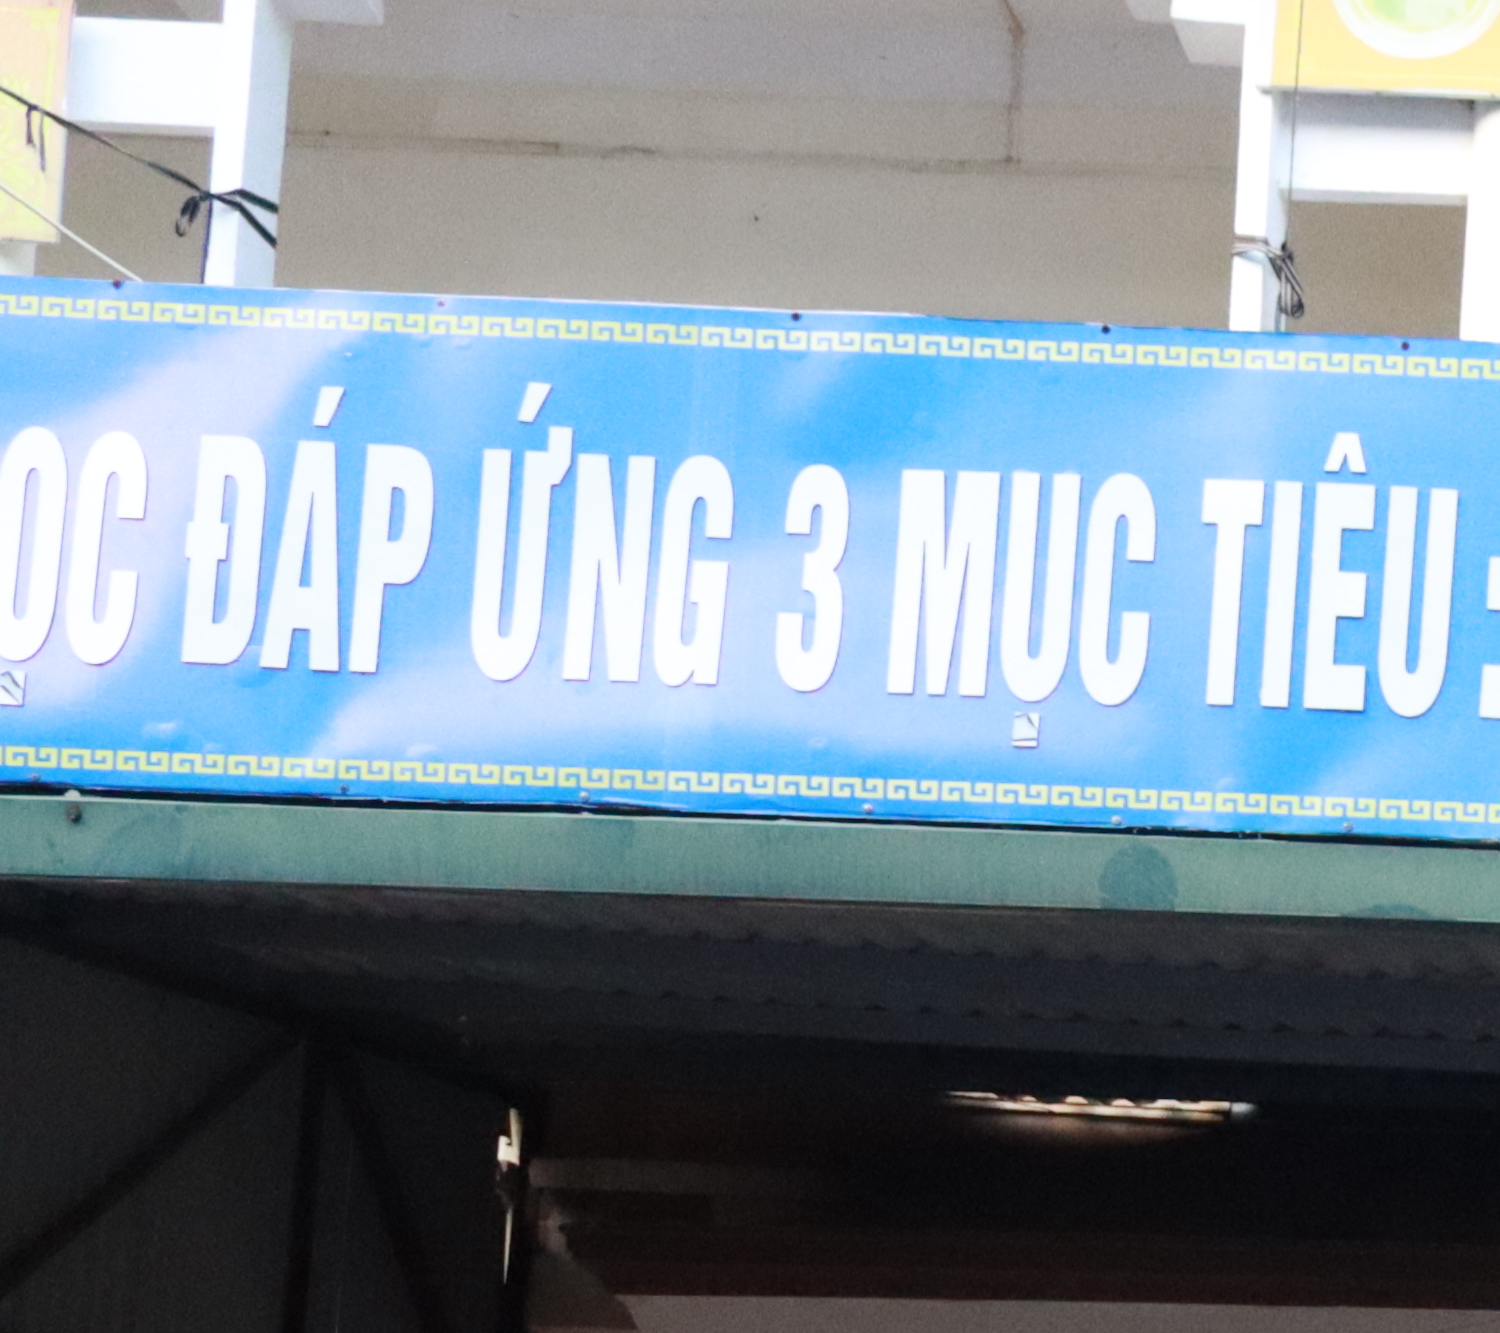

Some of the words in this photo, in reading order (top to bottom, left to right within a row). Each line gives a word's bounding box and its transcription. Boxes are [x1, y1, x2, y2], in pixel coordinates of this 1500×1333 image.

[181, 387, 434, 674] ĐÁP
[470, 381, 736, 687] ỨNG
[776, 464, 849, 694] 3
[885, 468, 1158, 748] MỤC
